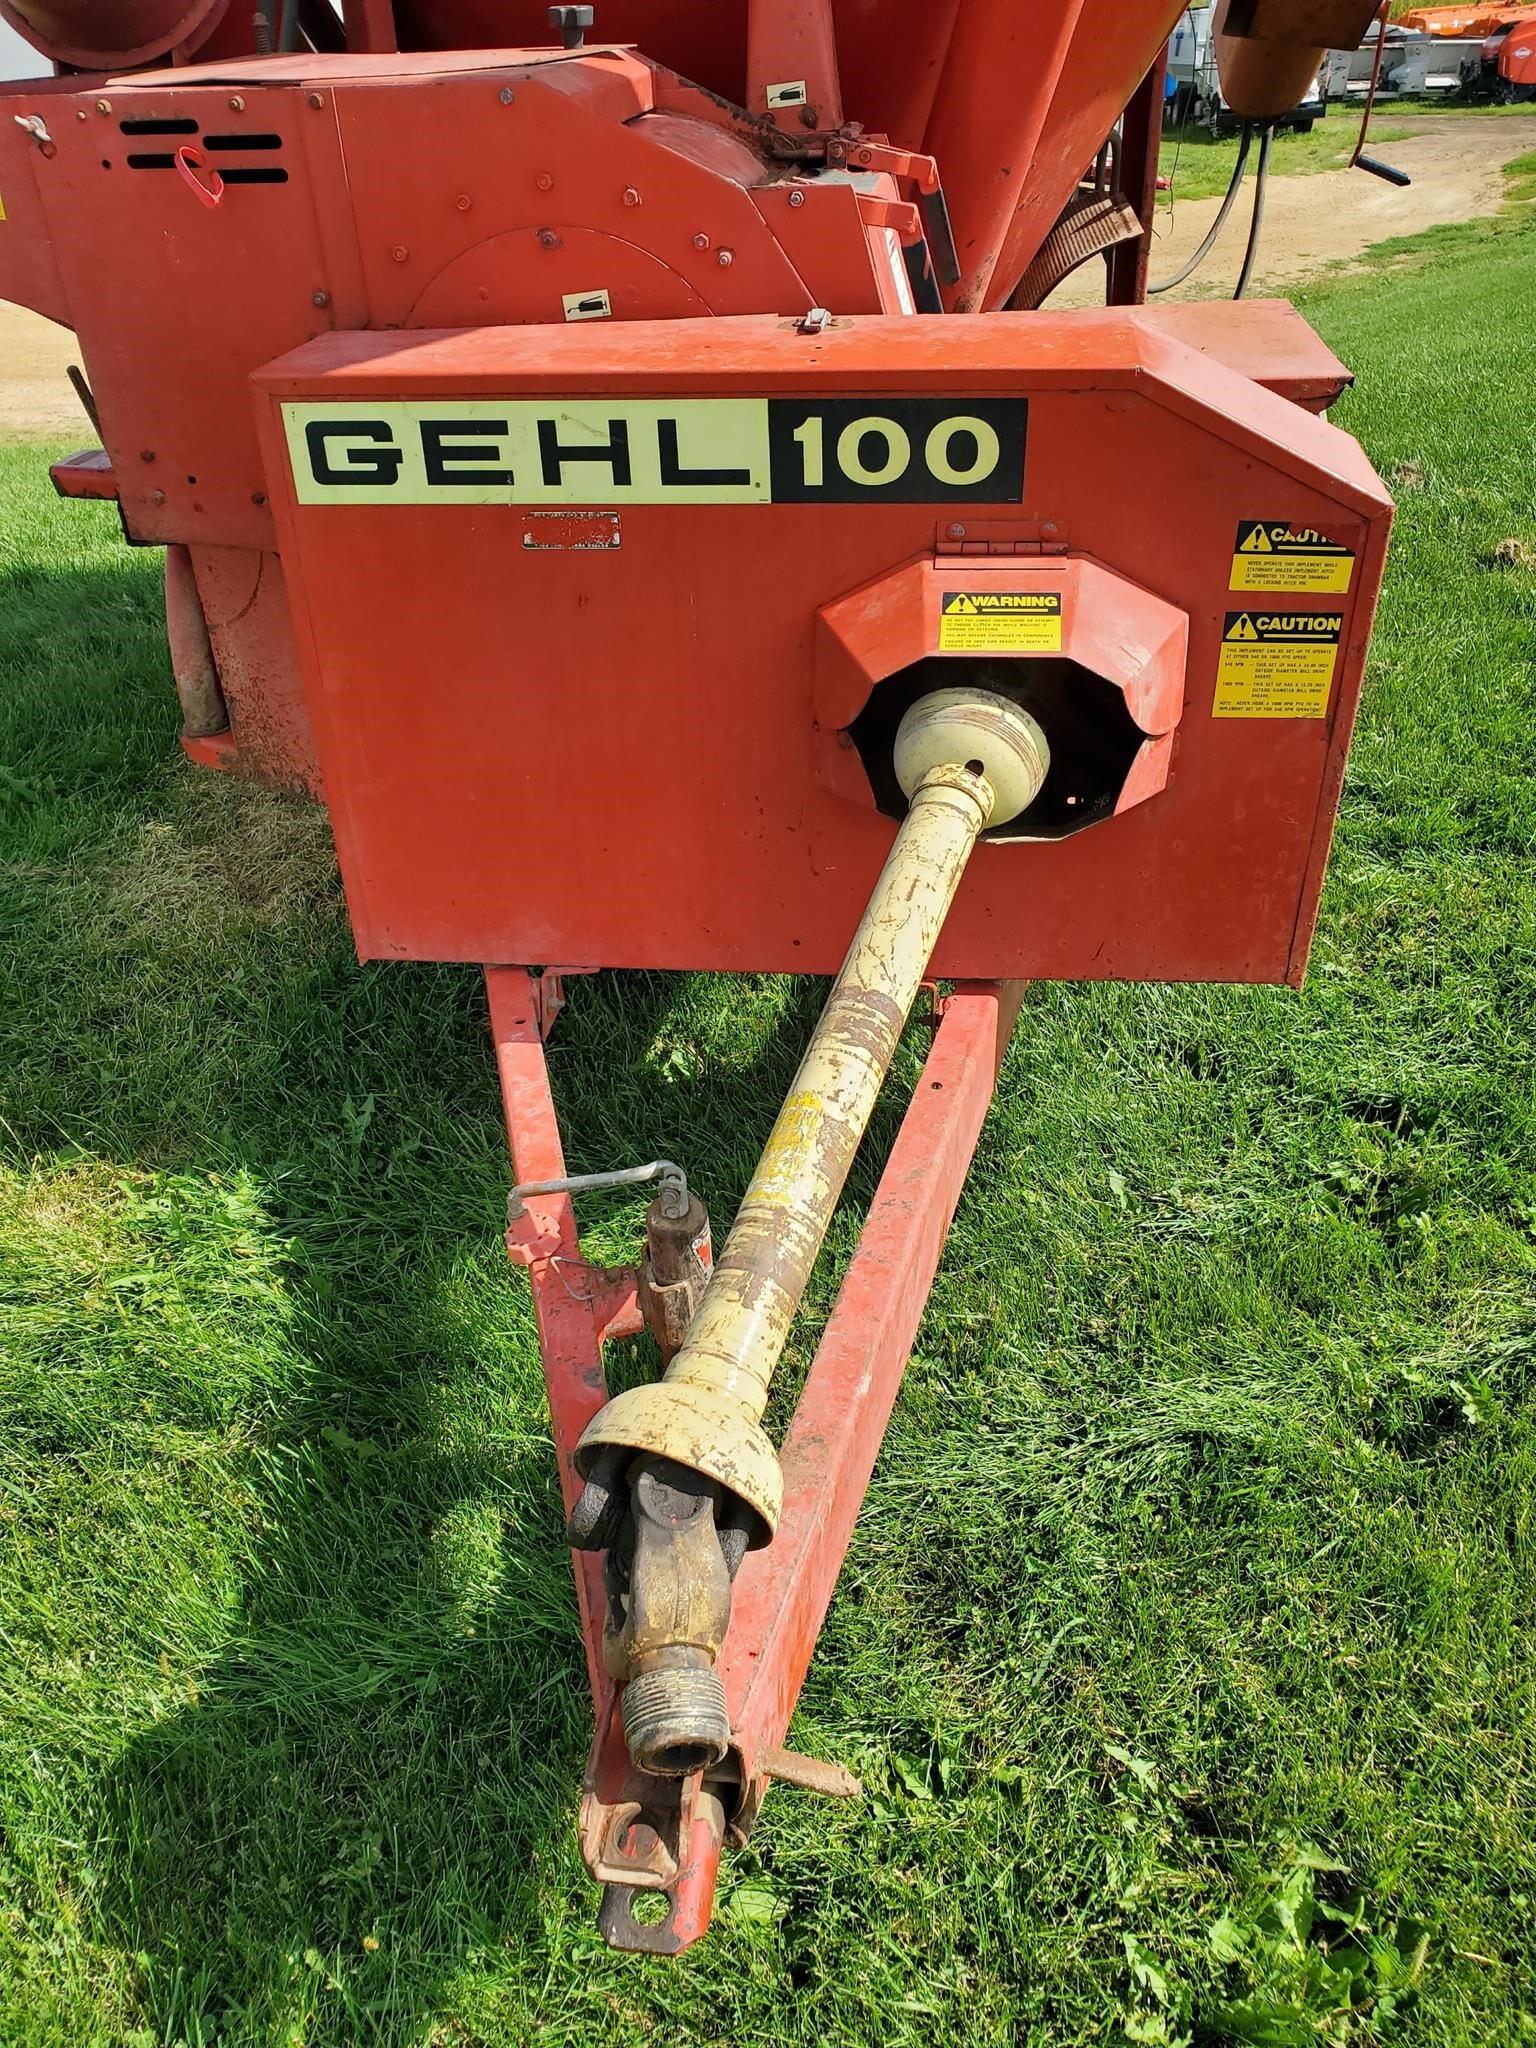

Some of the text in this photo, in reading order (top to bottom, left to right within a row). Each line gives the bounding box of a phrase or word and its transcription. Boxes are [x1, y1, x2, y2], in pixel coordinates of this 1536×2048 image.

[305, 419, 751, 486] GEHL
[792, 416, 1001, 487] 100
[971, 595, 1058, 607] WARNING
[1256, 616, 1342, 631] CAUTION
